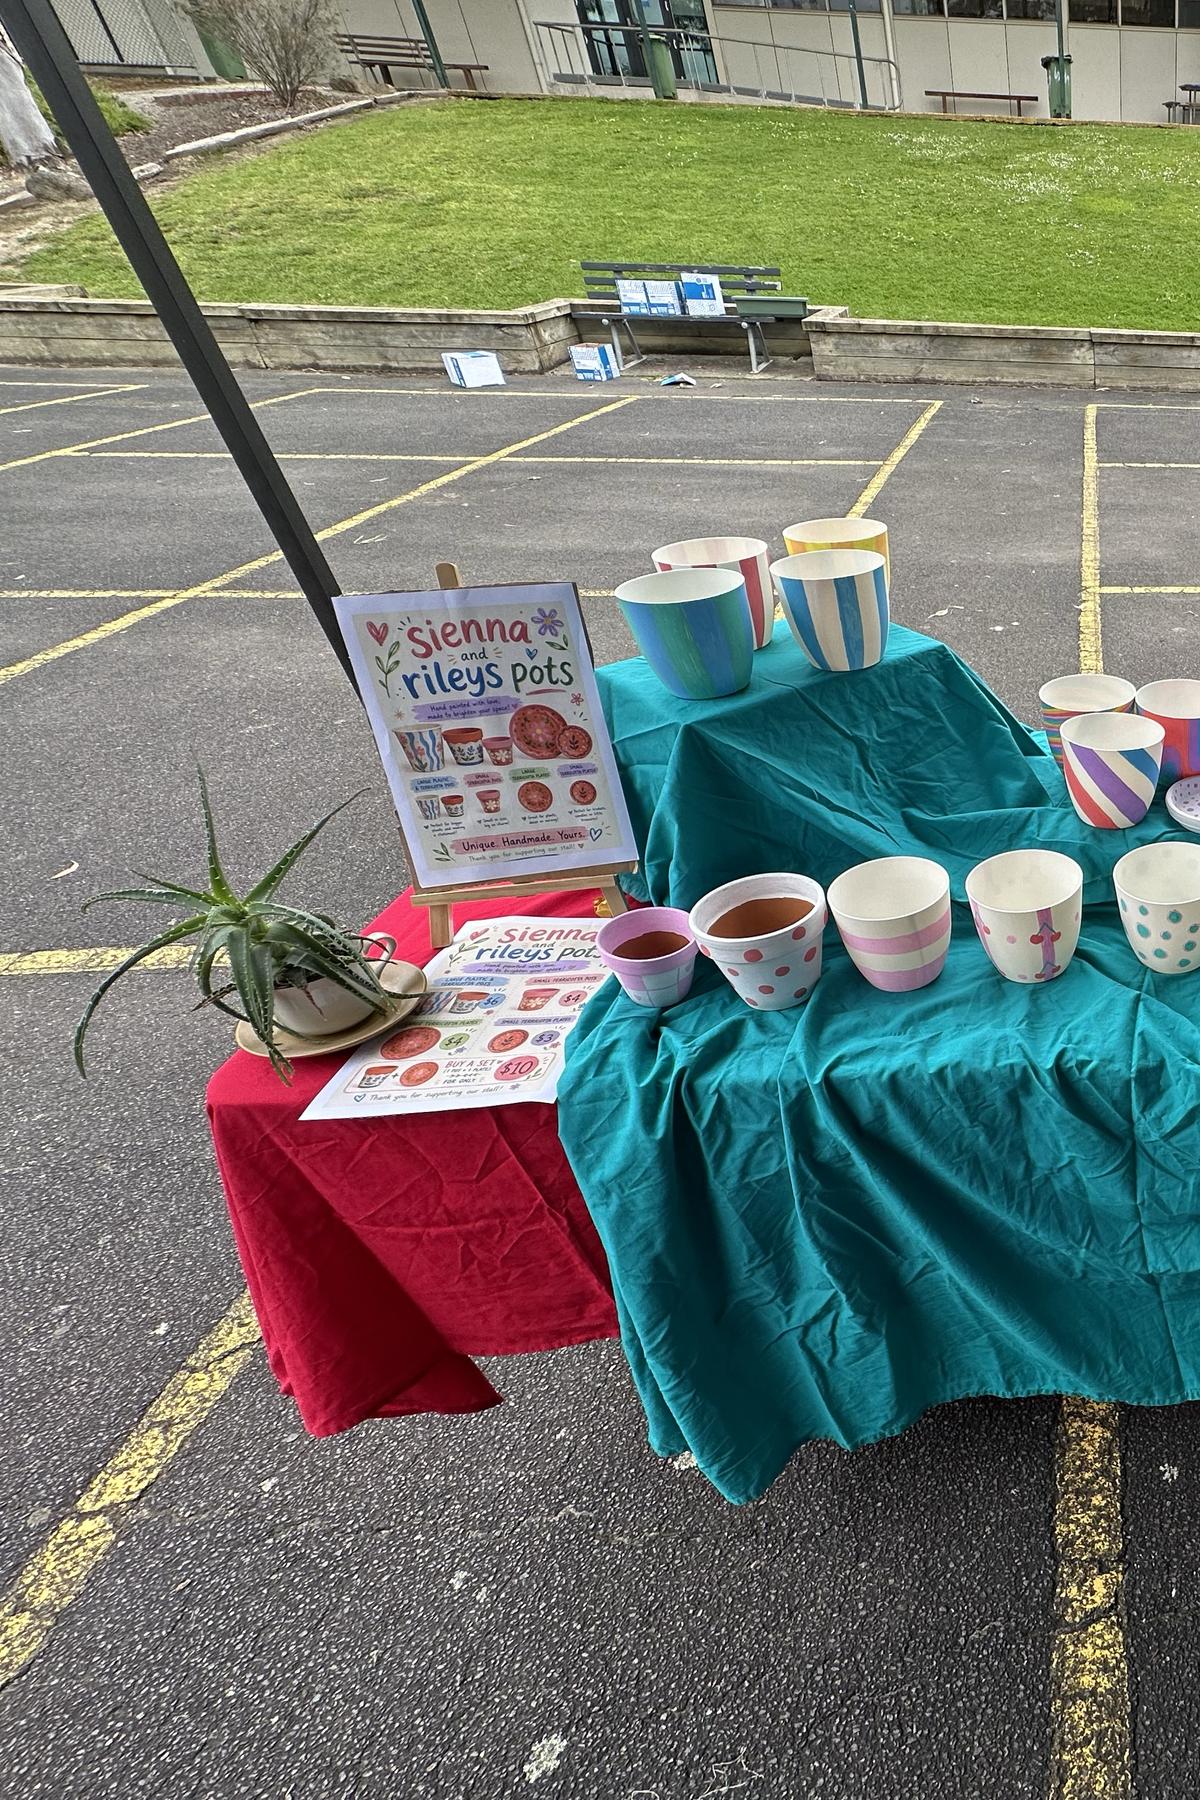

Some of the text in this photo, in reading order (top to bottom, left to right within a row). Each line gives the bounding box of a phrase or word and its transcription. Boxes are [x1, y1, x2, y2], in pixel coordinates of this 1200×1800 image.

[461, 648, 489, 661] and
[402, 656, 575, 699] rileys pots
[449, 702, 470, 711] painted
[453, 709, 477, 719] brighten
[502, 834, 555, 847] Handmade.
[557, 830, 585, 840] Yours.
[468, 854, 486, 862] Thank
[514, 847, 546, 856] supporting
[475, 944, 554, 963] rileys
[483, 996, 499, 1006] $6
[564, 994, 581, 1003] $4
[445, 1037, 463, 1046] $4
[536, 1033, 554, 1042] $3
[445, 1059, 497, 1068] BUY A SET
[500, 1060, 534, 1076] $10
[393, 1094, 407, 1102] you
[424, 1089, 463, 1099] supporting
[482, 1085, 504, 1093] stall!
